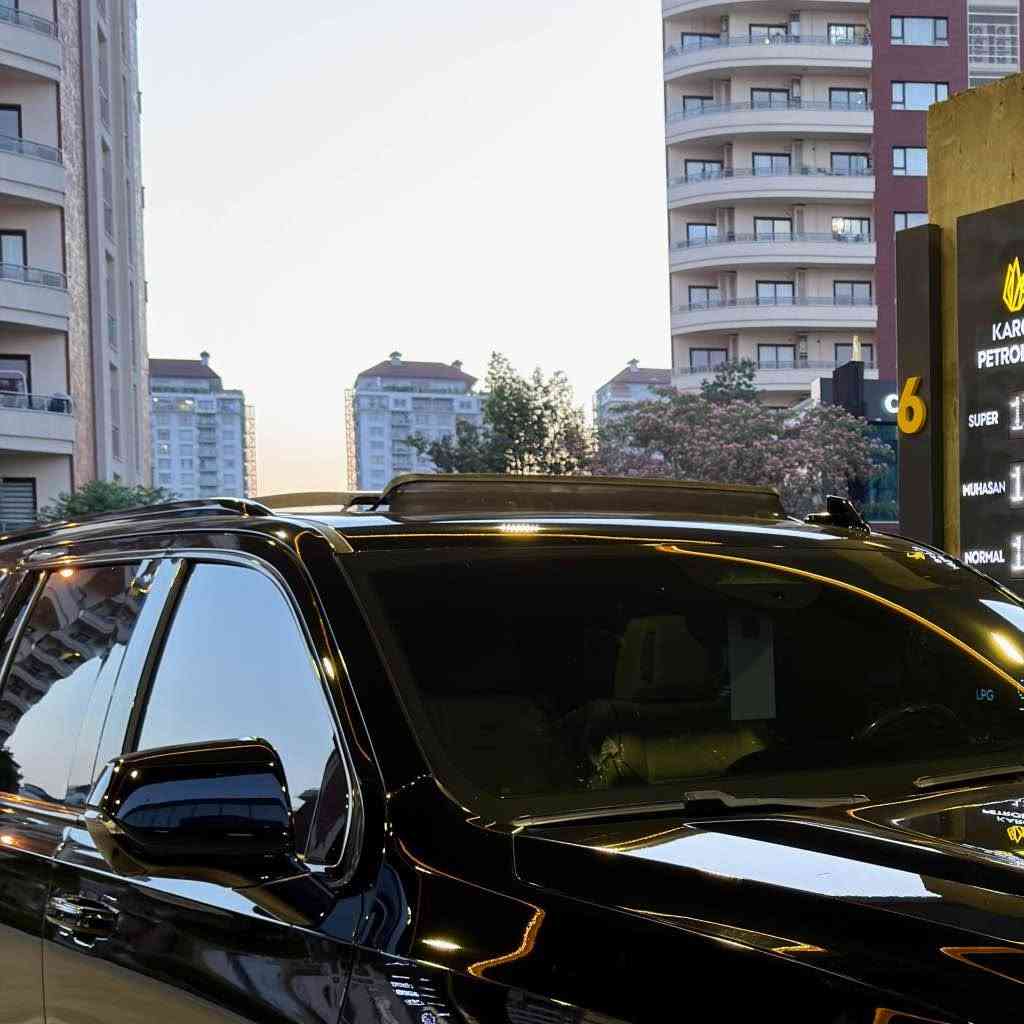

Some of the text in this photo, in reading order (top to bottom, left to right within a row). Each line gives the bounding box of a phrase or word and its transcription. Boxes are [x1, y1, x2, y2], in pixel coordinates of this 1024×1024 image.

[897, 376, 924, 433] 6
[968, 410, 999, 428] SUPER
[962, 481, 1006, 497] MUHASAN
[964, 549, 1006, 565] NORMAL
